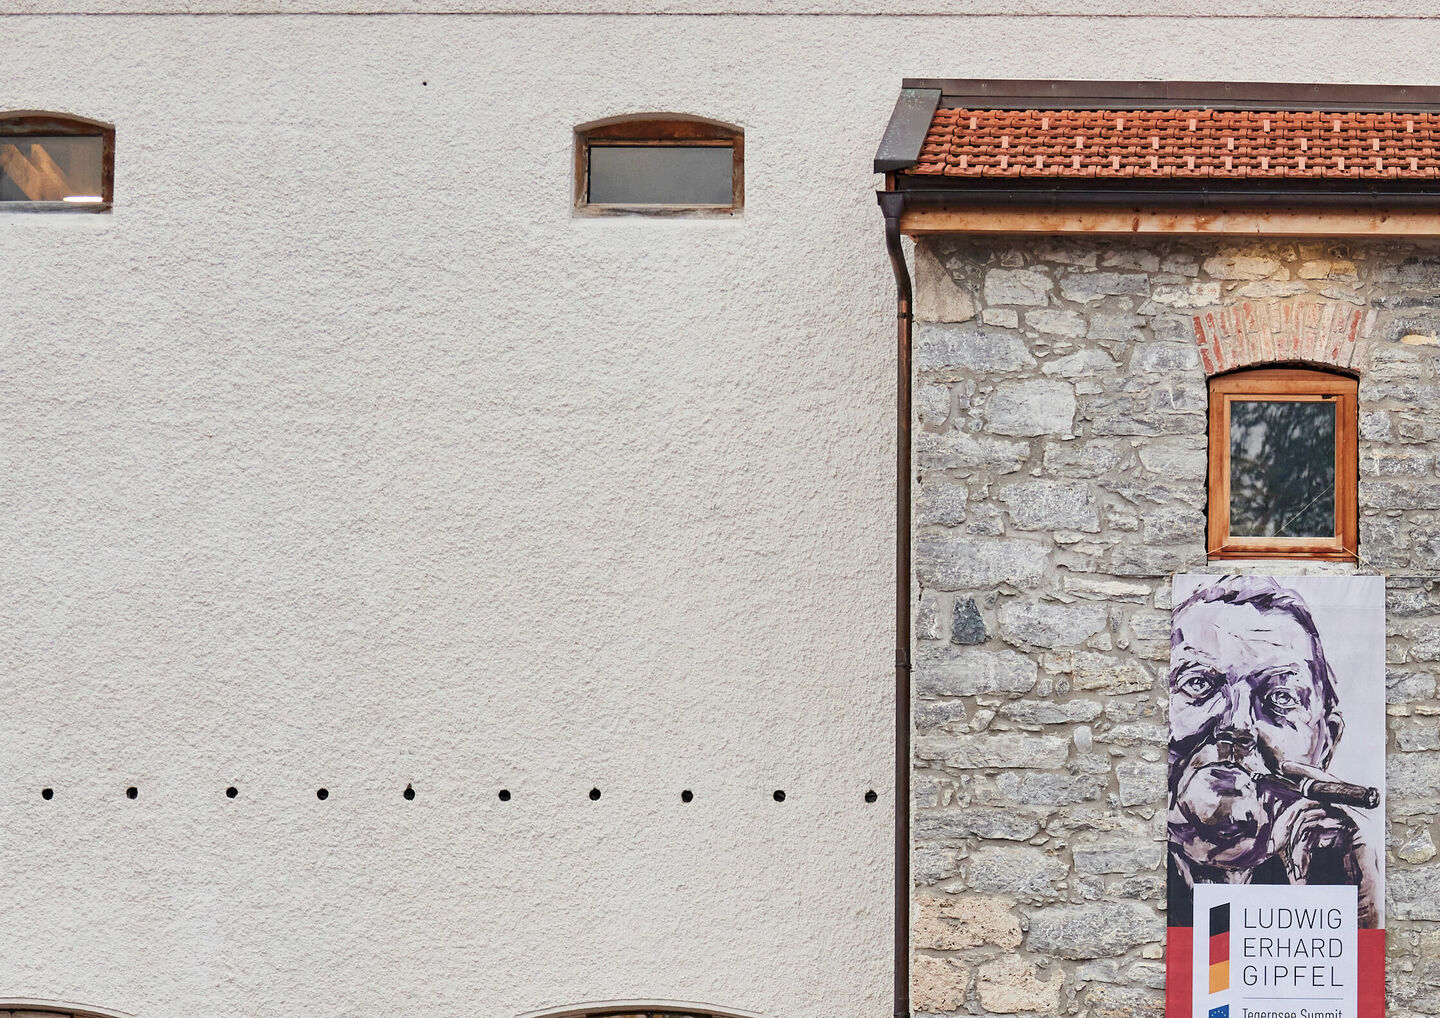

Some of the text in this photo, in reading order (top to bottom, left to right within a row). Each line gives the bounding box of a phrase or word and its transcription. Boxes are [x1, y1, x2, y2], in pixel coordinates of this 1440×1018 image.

[1243, 907, 1343, 930] LUDWIG
[1243, 937, 1344, 959] ERHARD
[1242, 965, 1344, 987] GIPFEL
